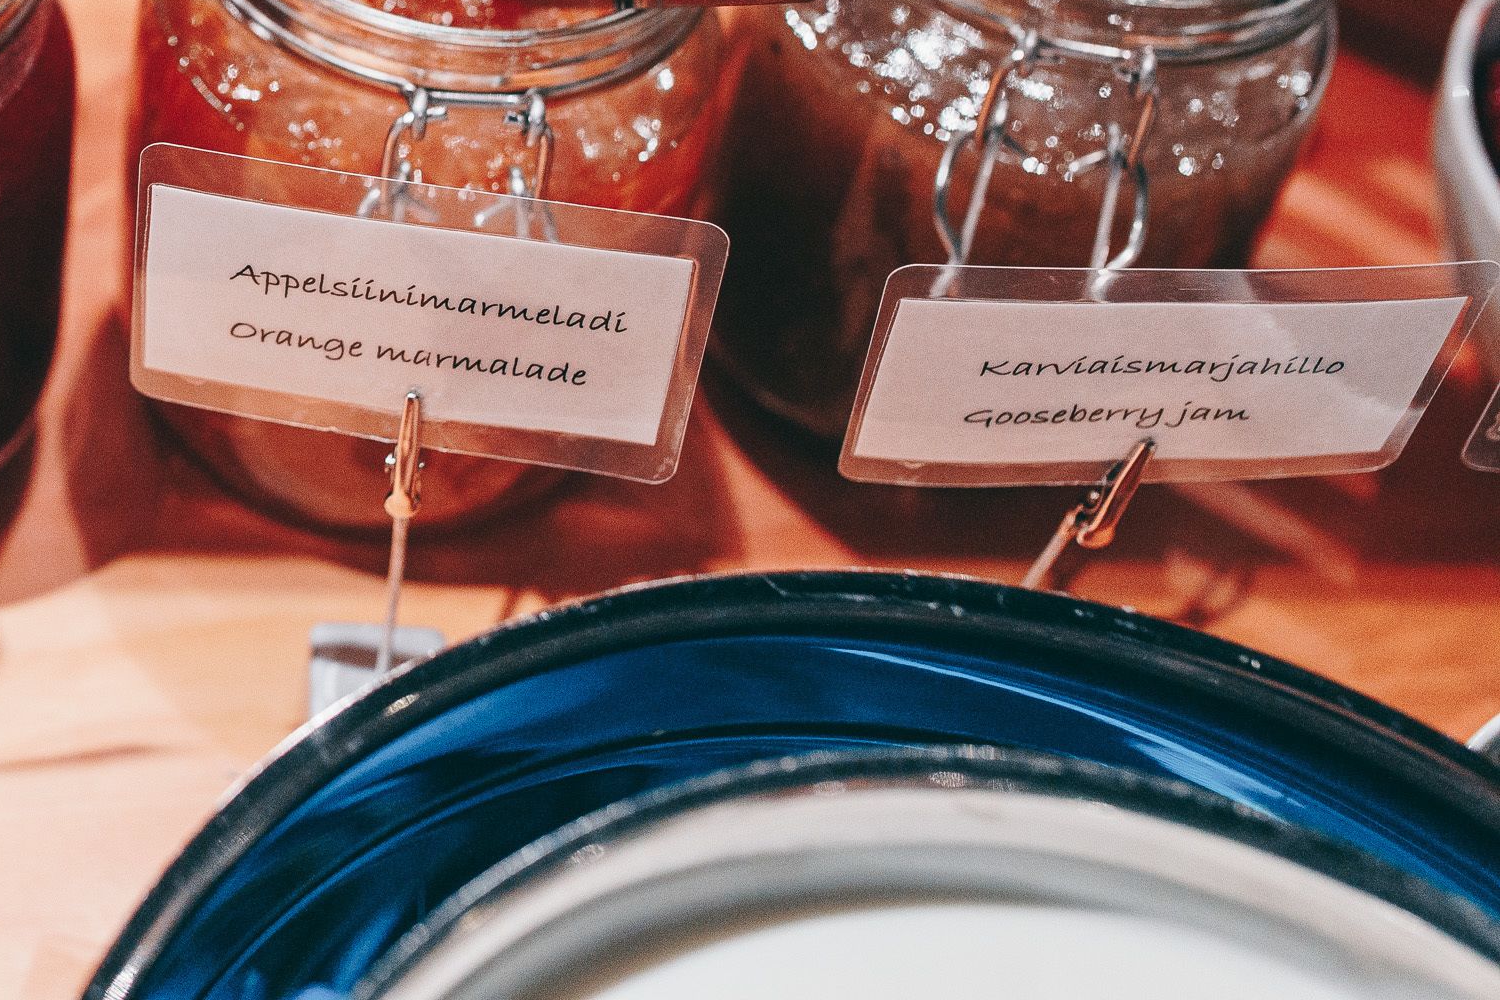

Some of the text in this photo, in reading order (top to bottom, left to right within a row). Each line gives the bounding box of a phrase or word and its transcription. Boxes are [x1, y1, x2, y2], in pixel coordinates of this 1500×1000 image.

[229, 264, 629, 333] Appelsiinimarmeladi
[229, 320, 588, 387] Orange marmalade
[979, 354, 1346, 383] Karviaismarjahillo
[963, 400, 1251, 430] Gooseberry jam
